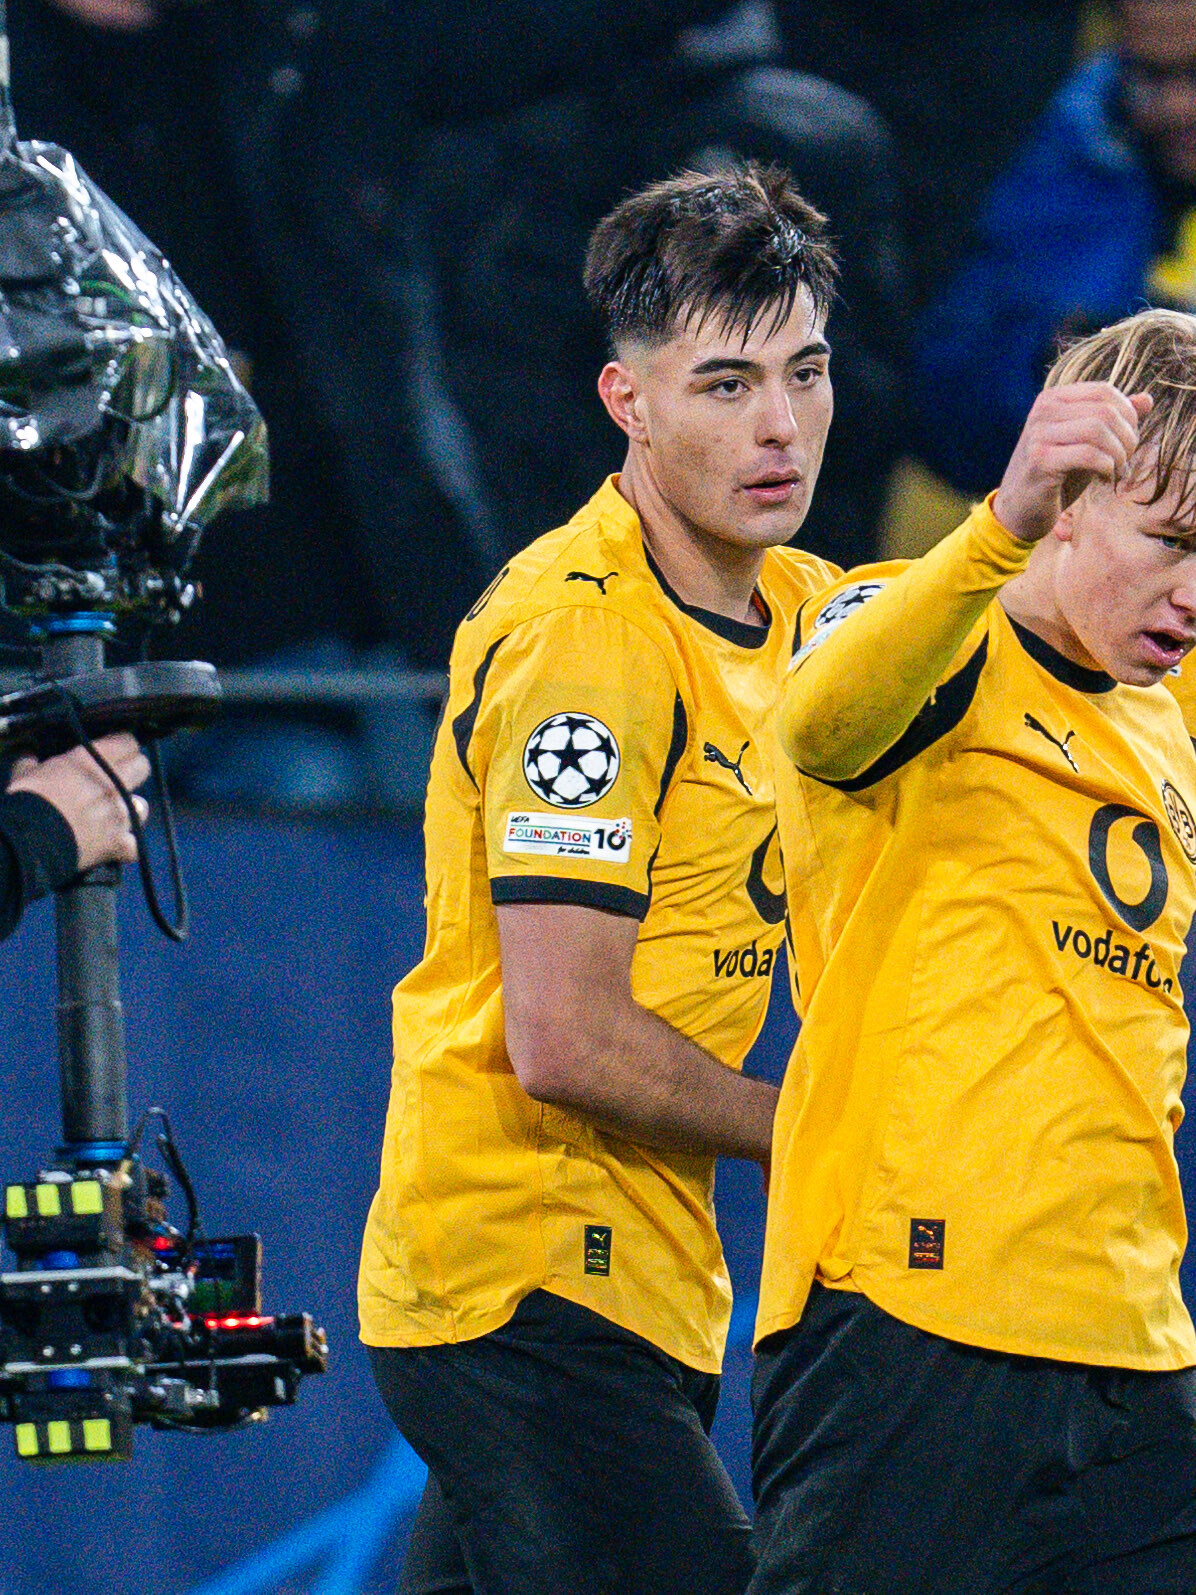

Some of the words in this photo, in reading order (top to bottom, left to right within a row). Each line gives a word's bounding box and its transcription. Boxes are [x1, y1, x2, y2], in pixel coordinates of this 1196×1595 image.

[510, 815, 530, 823] UEFA
[508, 827, 592, 844] FOUNDATION
[594, 827, 627, 851] 10
[713, 939, 775, 978] voda
